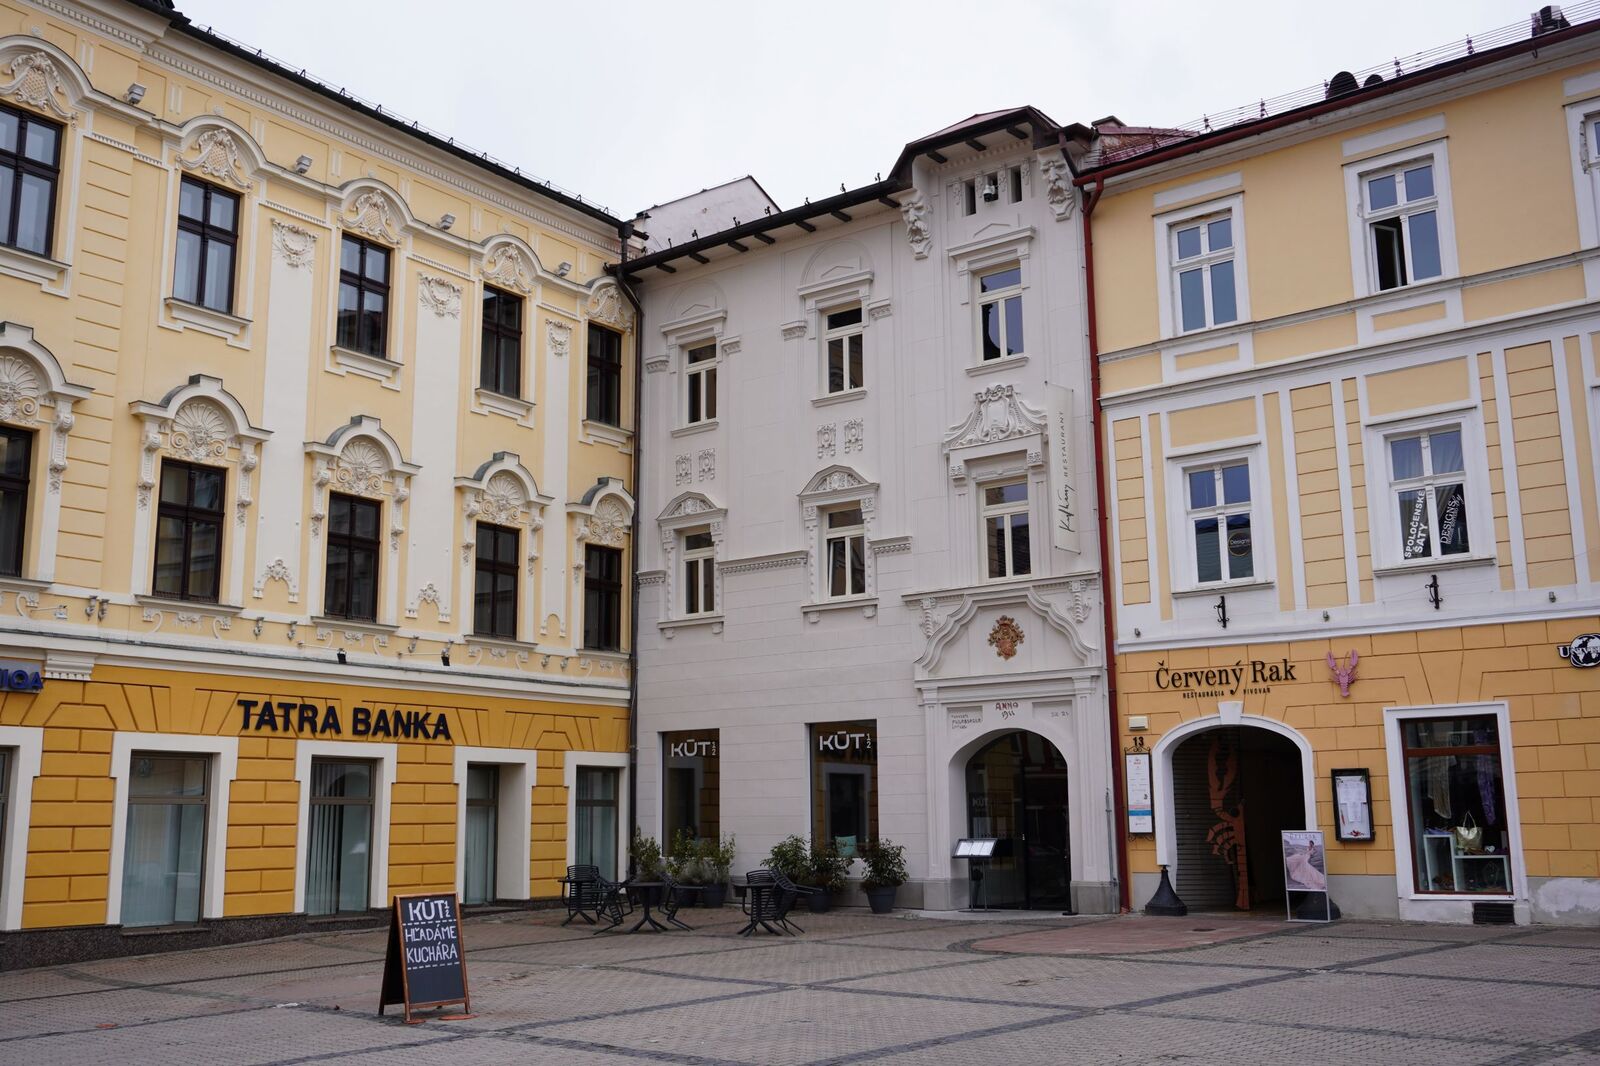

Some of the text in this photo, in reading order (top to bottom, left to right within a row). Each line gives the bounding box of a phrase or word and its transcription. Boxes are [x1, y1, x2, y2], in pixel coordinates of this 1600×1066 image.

[1059, 411, 1069, 478] RESTAURANT
[1404, 488, 1426, 558] SPOLOČENSKÉ
[1440, 499, 1458, 545] DESIGNS
[1413, 522, 1429, 554] ŠATY
[0, 668, 44, 690] IQA
[1155, 658, 1297, 696] Červený Rak
[1243, 687, 1271, 696] PIVOVAR
[995, 701, 1019, 711] ANNO
[237, 699, 451, 741] TATRA BANKA
[1133, 736, 1145, 747] 13
[405, 923, 458, 943] HĽADÁME
[406, 941, 458, 964] KUCHÁRA
